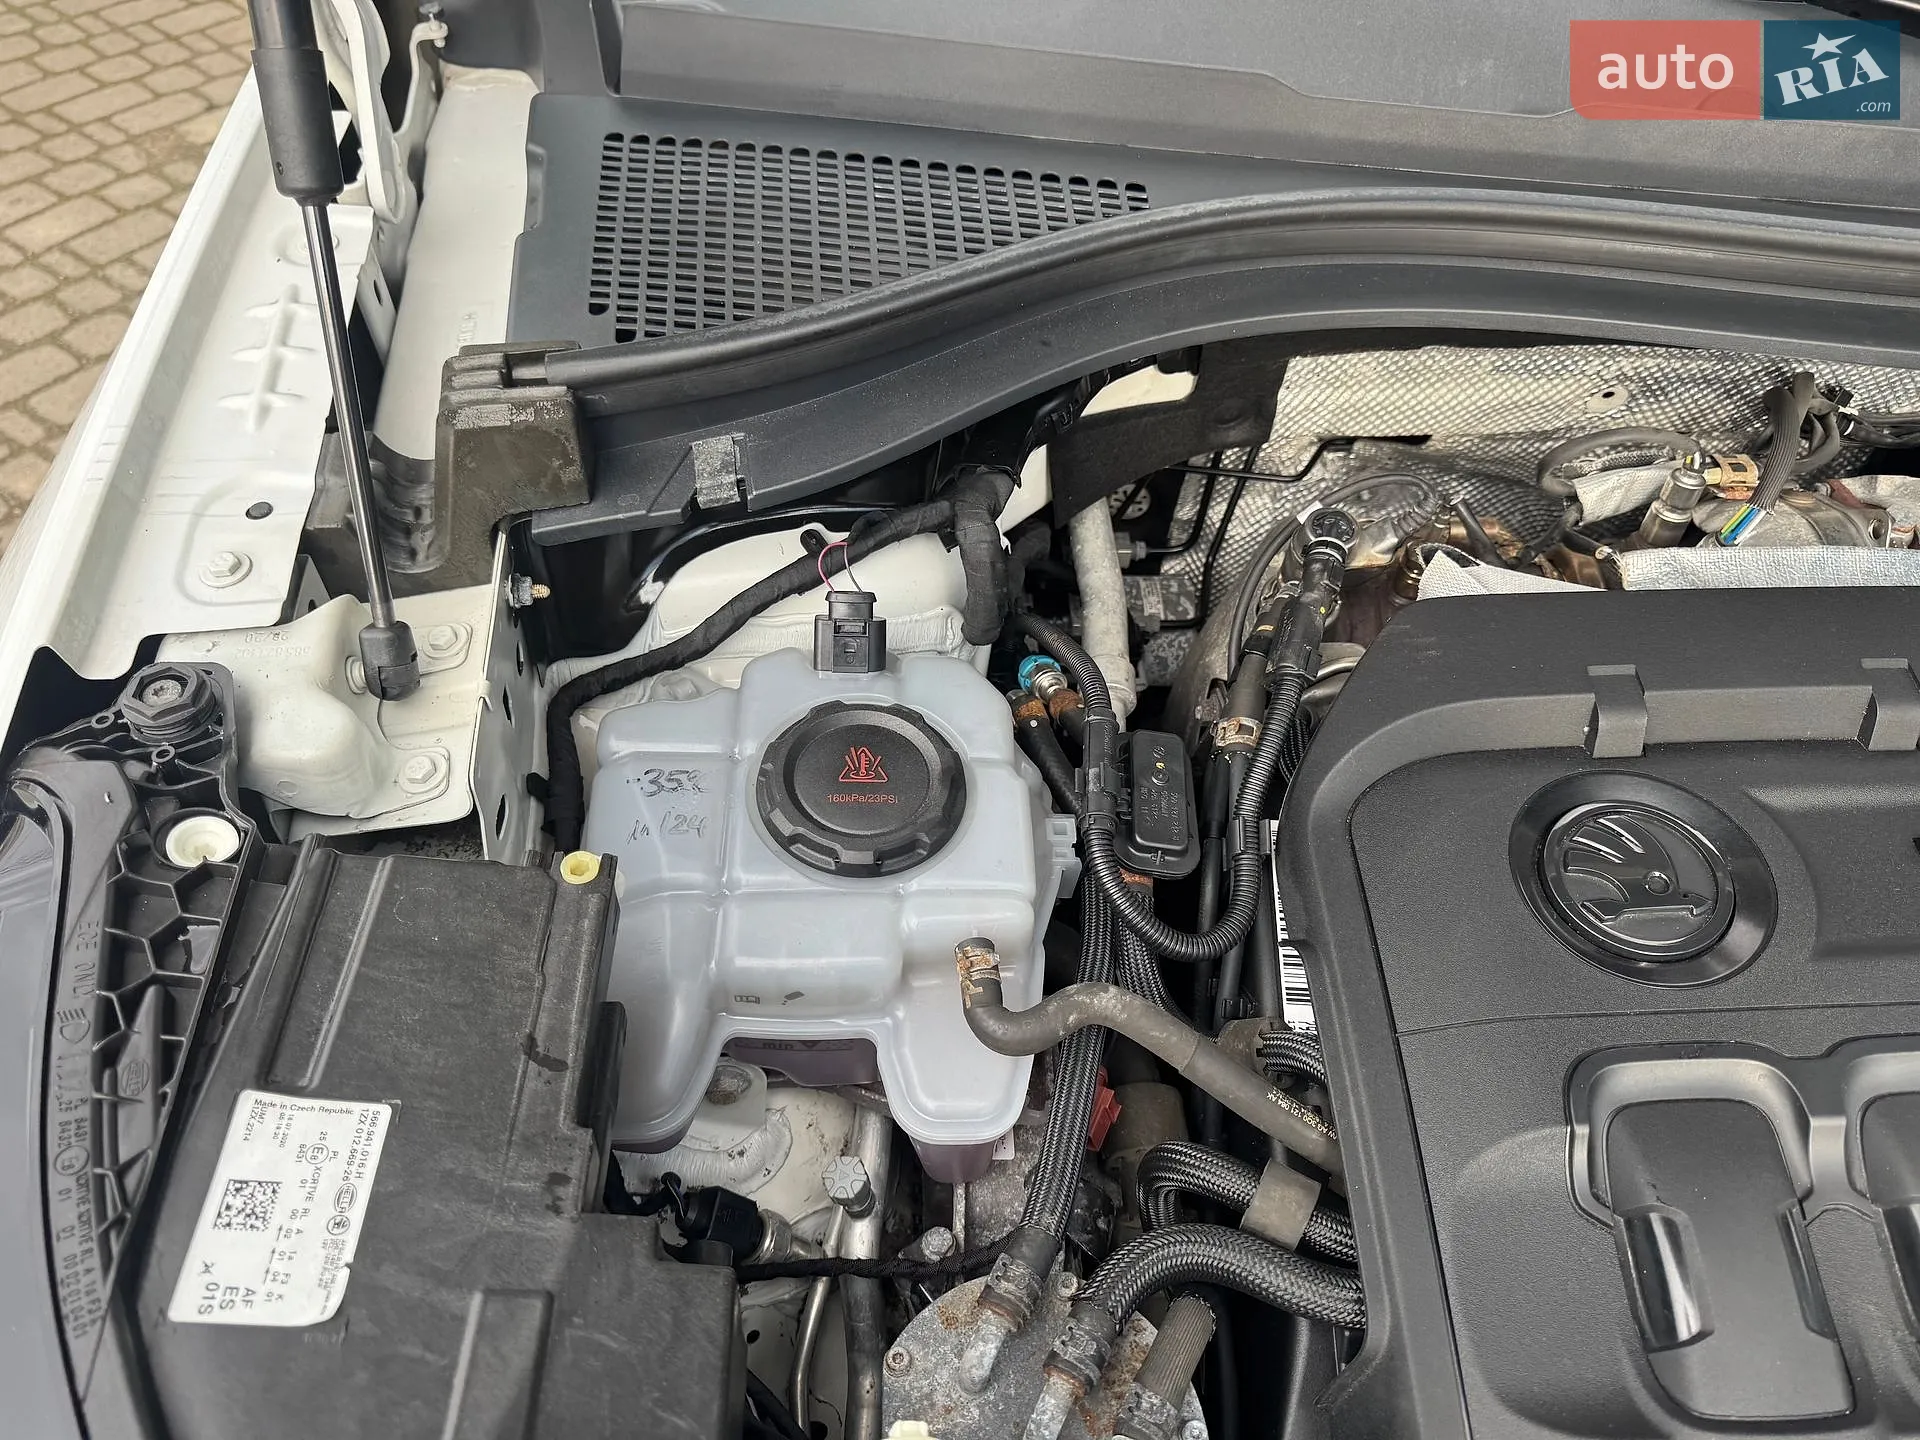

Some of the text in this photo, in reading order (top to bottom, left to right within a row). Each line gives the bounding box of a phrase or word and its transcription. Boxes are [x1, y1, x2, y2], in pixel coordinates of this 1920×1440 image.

[827, 793, 898, 804] 160kPa/23PSI
[76, 920, 100, 950] ECE
[254, 1099, 354, 1115] Made in Czech Republic
[1290, 1106, 1302, 1118] 121
[358, 1108, 370, 1126] 1ZX
[319, 1130, 328, 1142] 25
[329, 1150, 339, 1162] PL
[339, 1184, 352, 1214] HELLA
[197, 1282, 220, 1315] 01S
[219, 1286, 239, 1310] ES
[241, 1287, 257, 1309] AF
